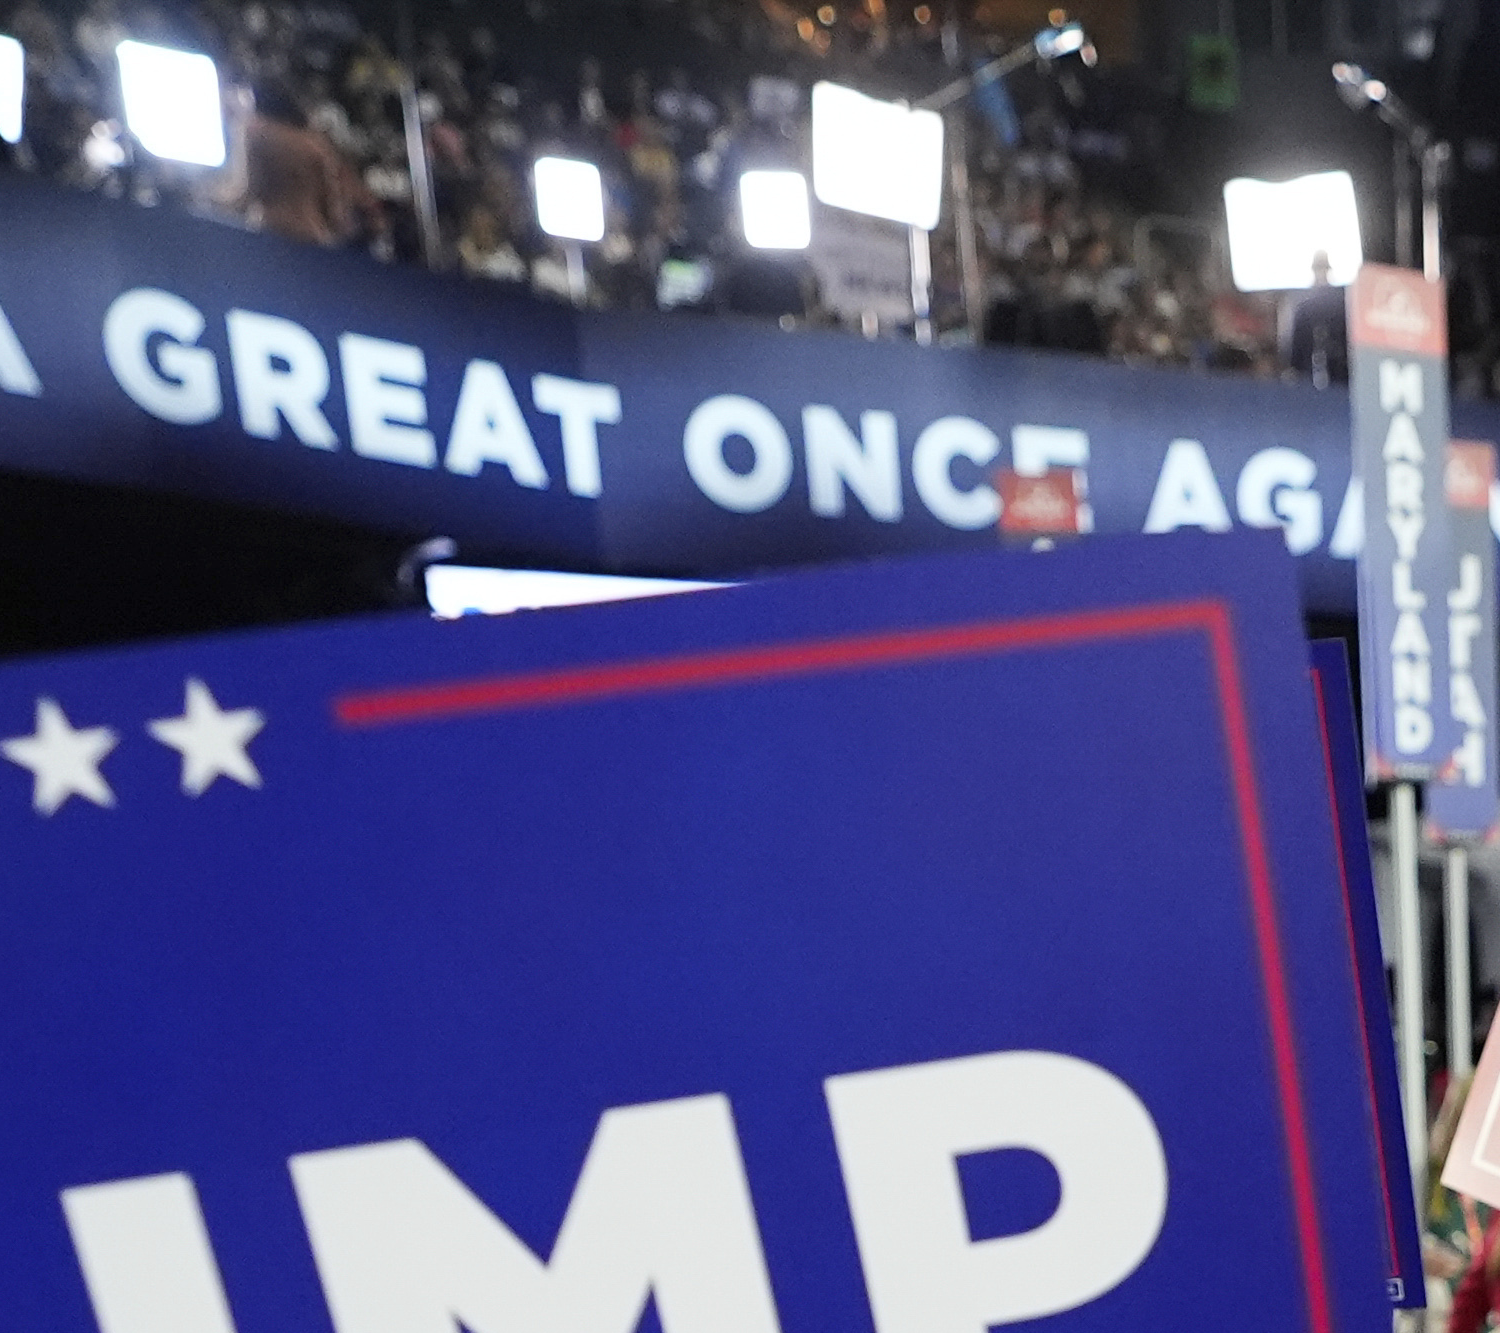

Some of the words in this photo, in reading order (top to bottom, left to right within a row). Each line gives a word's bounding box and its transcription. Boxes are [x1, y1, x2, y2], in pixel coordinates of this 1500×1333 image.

[102, 287, 621, 497] GREAT
[683, 394, 1095, 534] ONCE
[1379, 358, 1434, 755] MARYLAND
